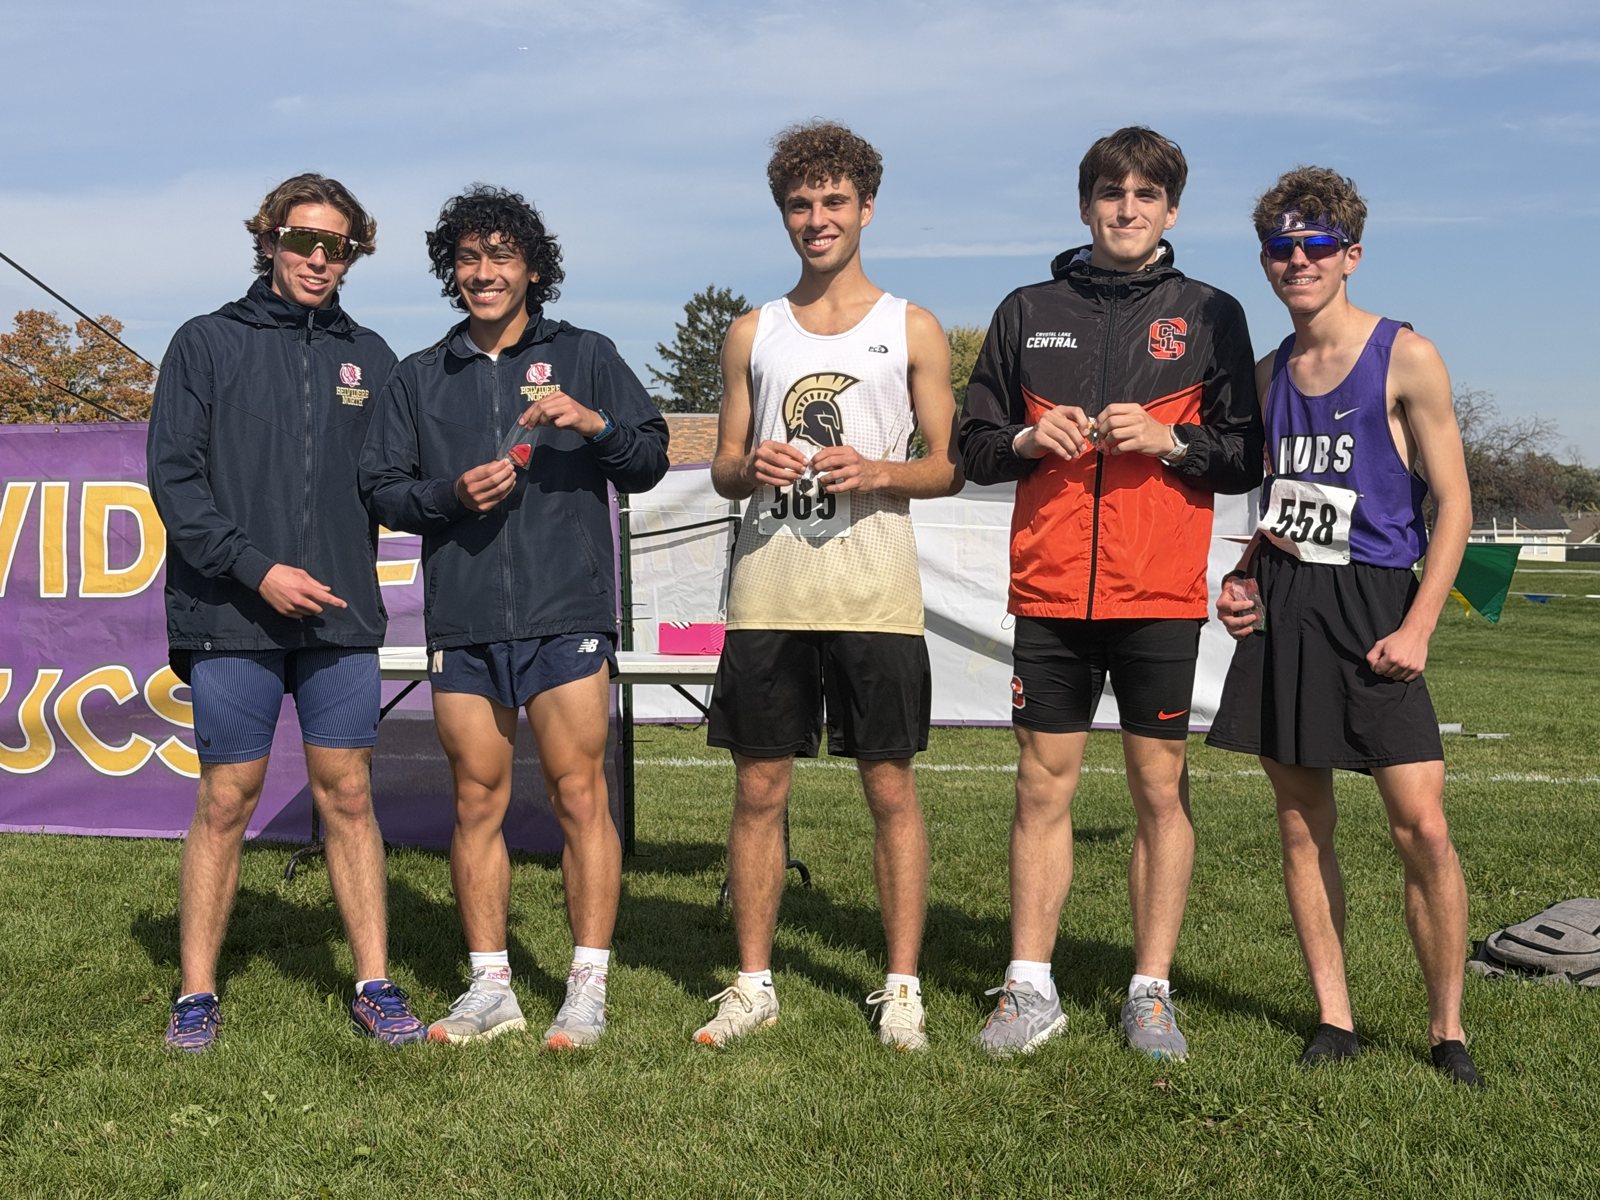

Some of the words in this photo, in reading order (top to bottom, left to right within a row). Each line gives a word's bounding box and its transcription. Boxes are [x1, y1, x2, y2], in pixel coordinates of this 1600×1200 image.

[1026, 337, 1078, 348] CENTRAL
[1277, 433, 1356, 476] HUBS
[1270, 498, 1338, 546] 558
